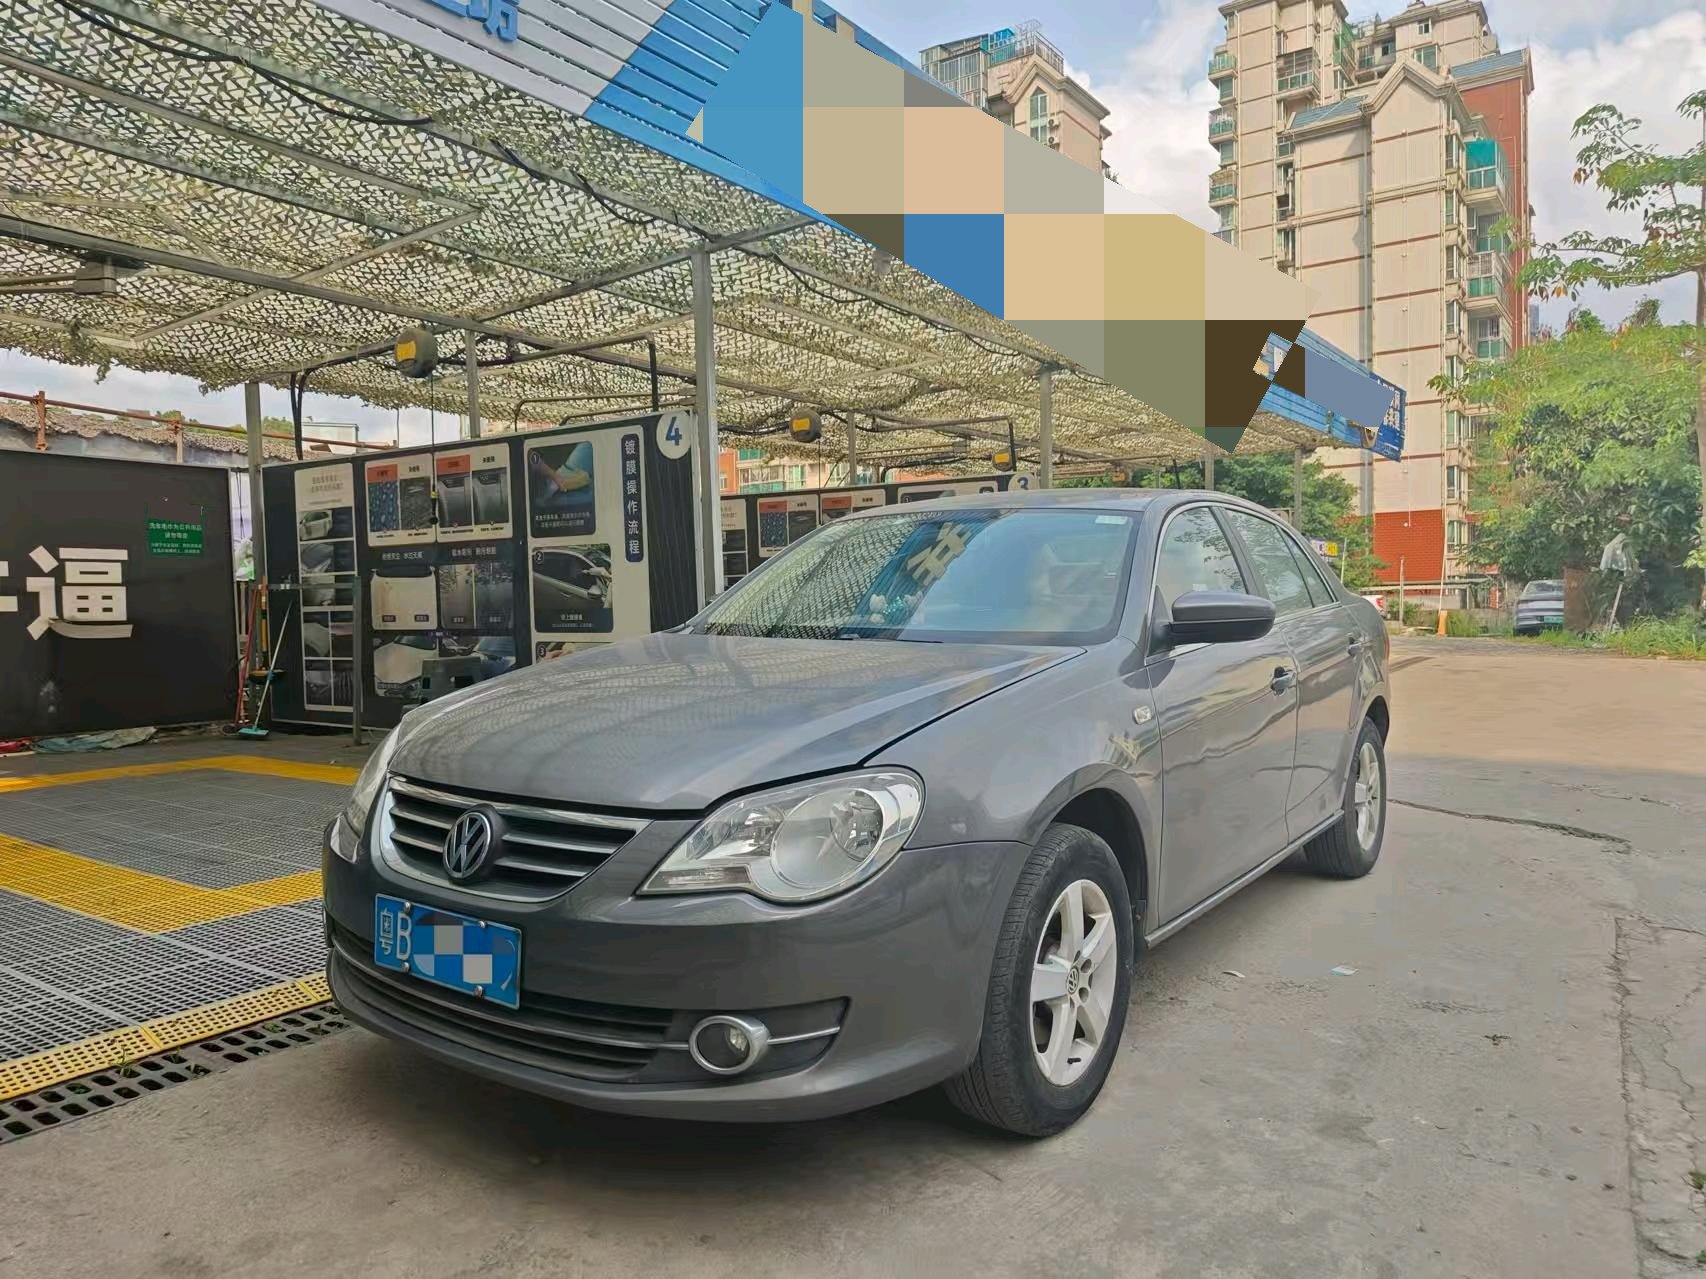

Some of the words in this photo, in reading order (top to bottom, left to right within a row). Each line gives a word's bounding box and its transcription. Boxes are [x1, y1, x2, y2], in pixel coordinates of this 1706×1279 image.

[665, 416, 682, 446] 4
[624, 440, 641, 555] 镀膜操作流程
[0, 545, 134, 640] 逼
